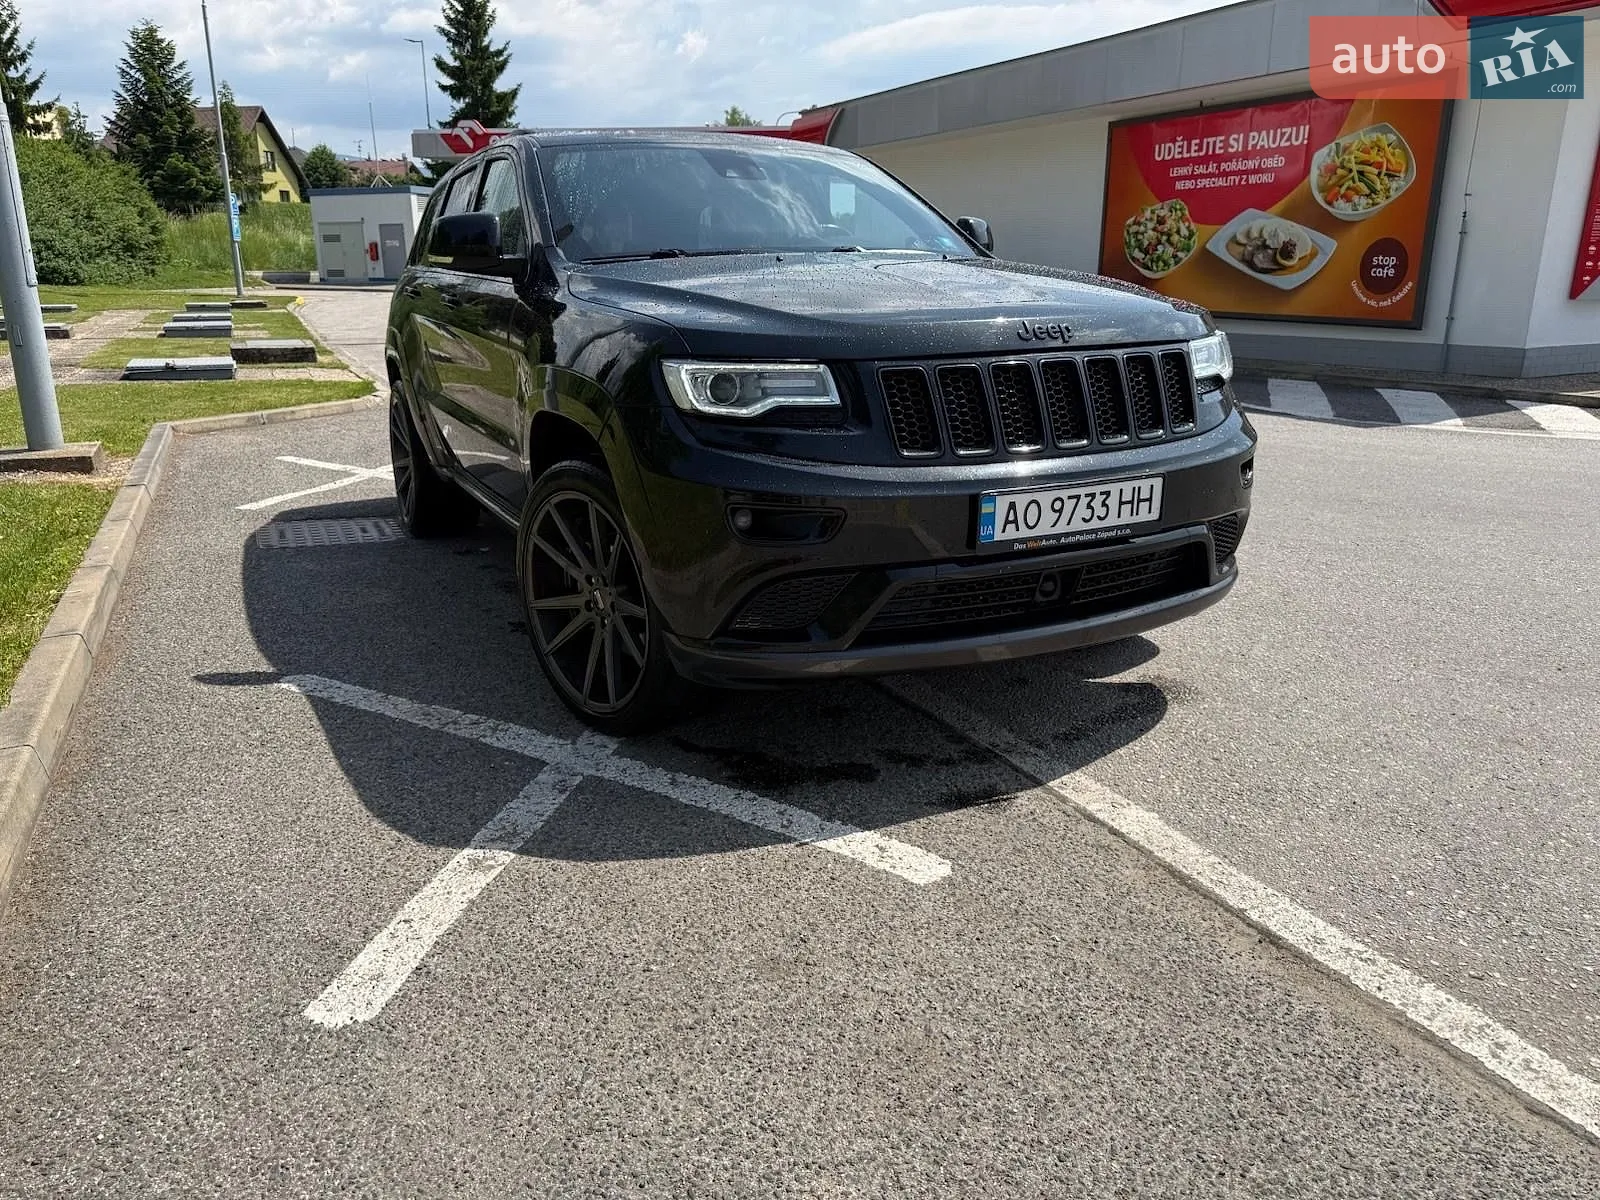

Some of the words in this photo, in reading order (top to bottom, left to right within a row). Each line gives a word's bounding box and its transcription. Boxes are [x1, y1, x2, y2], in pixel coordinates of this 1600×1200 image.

[1154, 136, 1225, 161] UDĚLEJTE
[1228, 133, 1243, 153] SI
[1247, 125, 1310, 150] PAUZU!
[1169, 163, 1193, 177] LEHKÝ
[1193, 161, 1219, 175] SALÁT,
[1220, 157, 1261, 172] POŘÁDNÝ
[1260, 154, 1285, 169] OBĚD
[1175, 179, 1196, 191] NEBO
[1197, 175, 1241, 189] SPECIALITY
[1241, 175, 1249, 185] Z
[1249, 172, 1275, 184] WOKU
[1372, 255, 1397, 268] stop
[1017, 320, 1074, 343] Jeep
[1001, 499, 1042, 533] AO
[1050, 490, 1111, 528] 9733
[1117, 484, 1154, 518] HH
[980, 525, 993, 536] UA
[1013, 542, 1027, 550] Das
